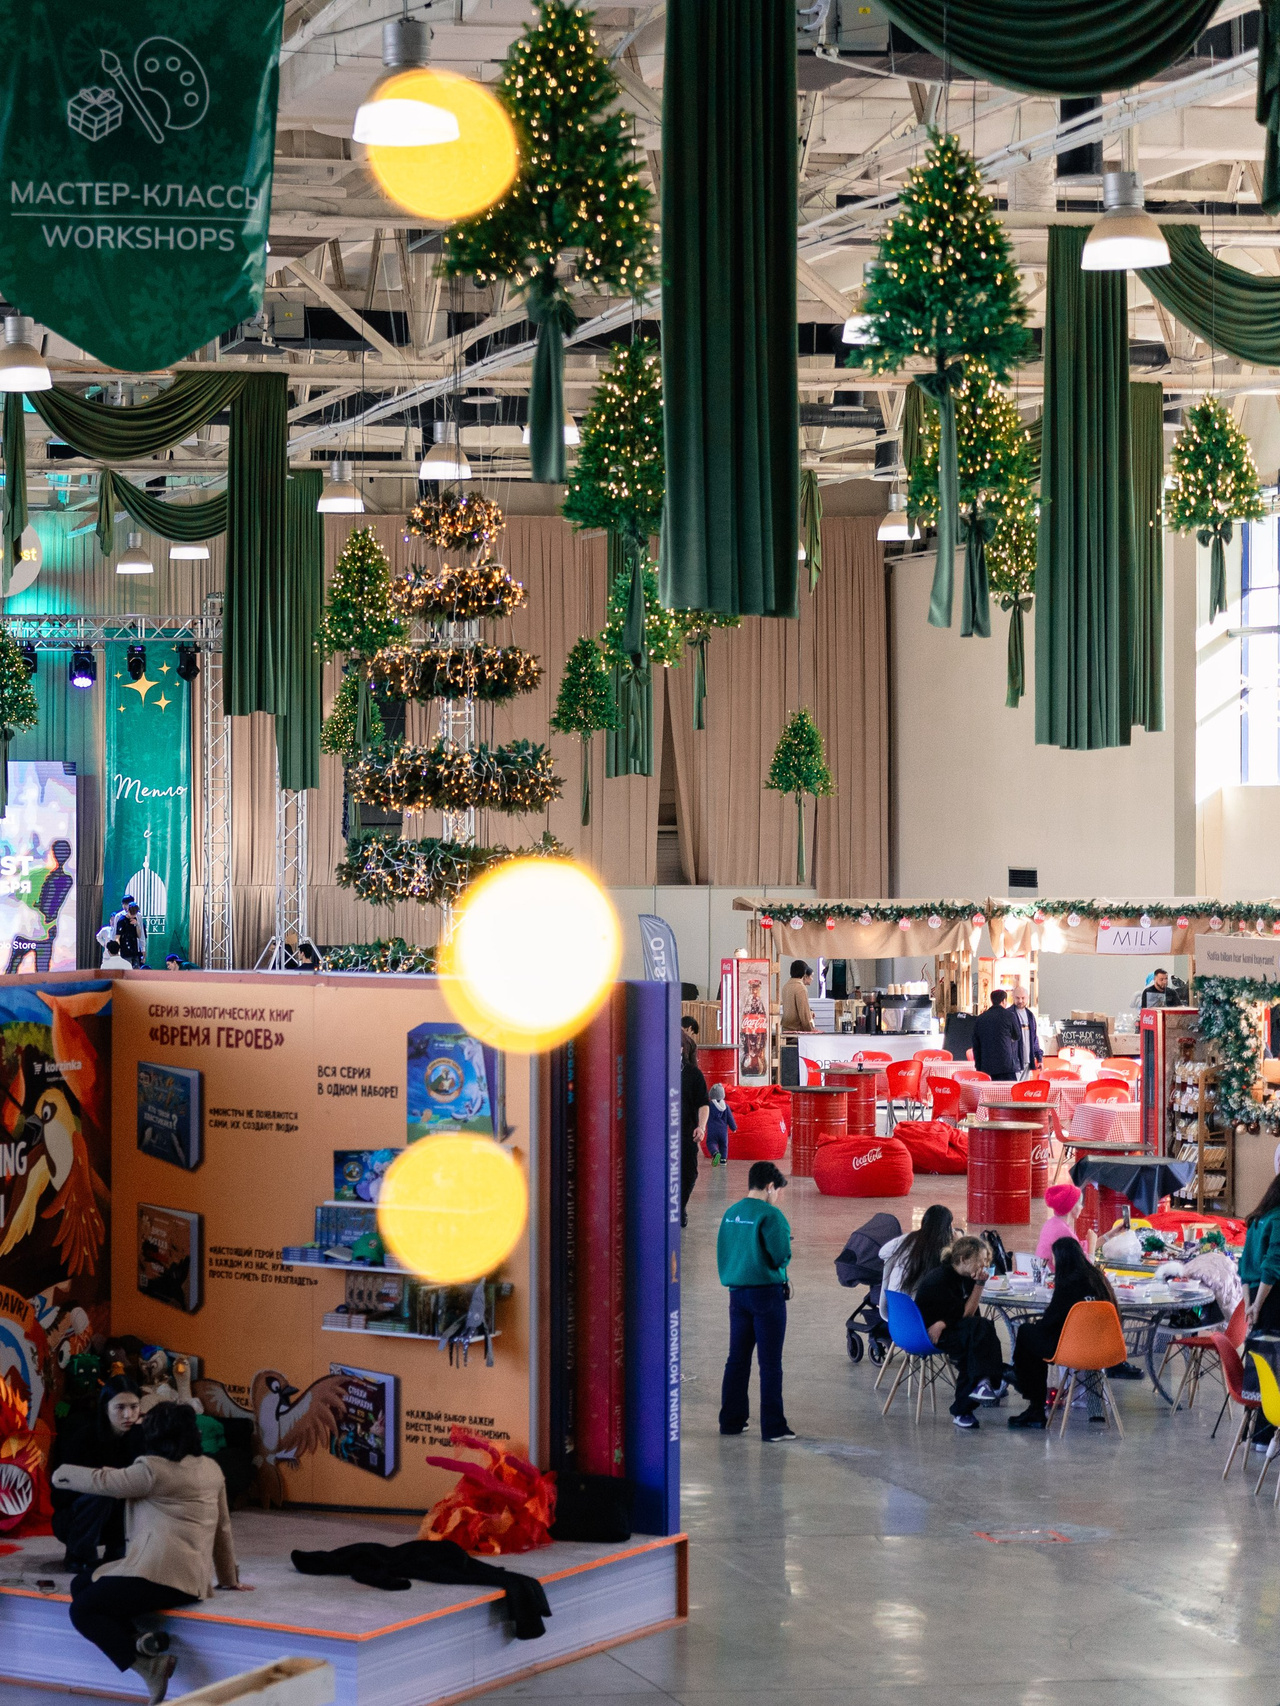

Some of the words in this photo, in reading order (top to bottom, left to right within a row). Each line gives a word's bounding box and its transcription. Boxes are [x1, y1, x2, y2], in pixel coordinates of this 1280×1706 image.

[10, 180, 262, 212] МАСТЕР-КЛАССЫ
[41, 224, 236, 251] WORKSHOPS
[12, 941, 37, 950] Store
[1112, 930, 1159, 947] MILK
[148, 1004, 179, 1018] СЕРИЯ
[183, 1006, 266, 1022] ЭКОЛОГИЧЕСКИХ
[269, 1009, 295, 1023] КНИГ
[149, 1025, 211, 1047] «ВРЕМЯ
[216, 1027, 285, 1050] ГЕРОЕВ»
[317, 1066, 337, 1078] ВСЯ
[340, 1066, 371, 1079] СЕРИЯ
[317, 1083, 324, 1095] В
[327, 1084, 358, 1098] ОДНОМ
[361, 1085, 399, 1099] НАБОРЕ!
[246, 1109, 254, 1118] НЕ
[669, 1103, 680, 1127] KIM
[230, 1120, 240, 1130] ИХ
[851, 1146, 883, 1171] Coca-Cola
[669, 1130, 680, 1224] PLASTIKAKL
[254, 1248, 274, 1259] ГЕРОЙ
[244, 1260, 254, 1269] ИЗ
[209, 1269, 233, 1280] ПРОСТО
[261, 1272, 273, 1283] ЕГО
[443, 1412, 467, 1424] ВЫБОР
[669, 1387, 680, 1443] MADINA
[405, 1421, 432, 1434] ВМЕСТЕ
[433, 1424, 446, 1434] МЫ
[405, 1434, 420, 1444] МИР
[421, 1435, 427, 1444] К
